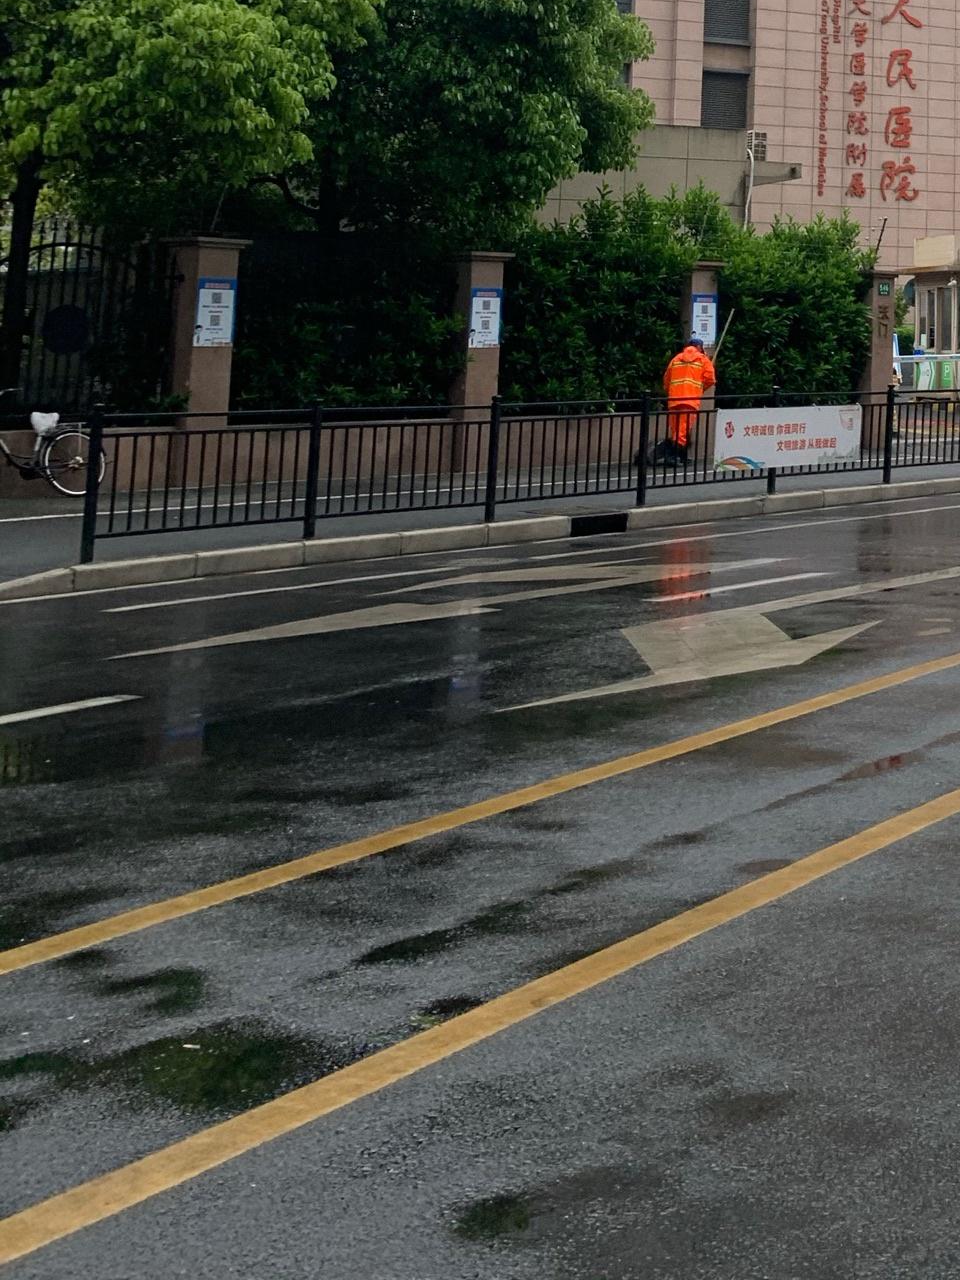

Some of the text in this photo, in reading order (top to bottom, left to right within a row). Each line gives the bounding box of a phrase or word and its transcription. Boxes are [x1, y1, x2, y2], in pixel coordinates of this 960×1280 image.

[831, 0, 842, 44] Hospital
[817, 147, 827, 197] Medicine
[743, 423, 806, 437] 文明诚信 你我同行
[776, 437, 837, 451] 文明旅游 从我做起
